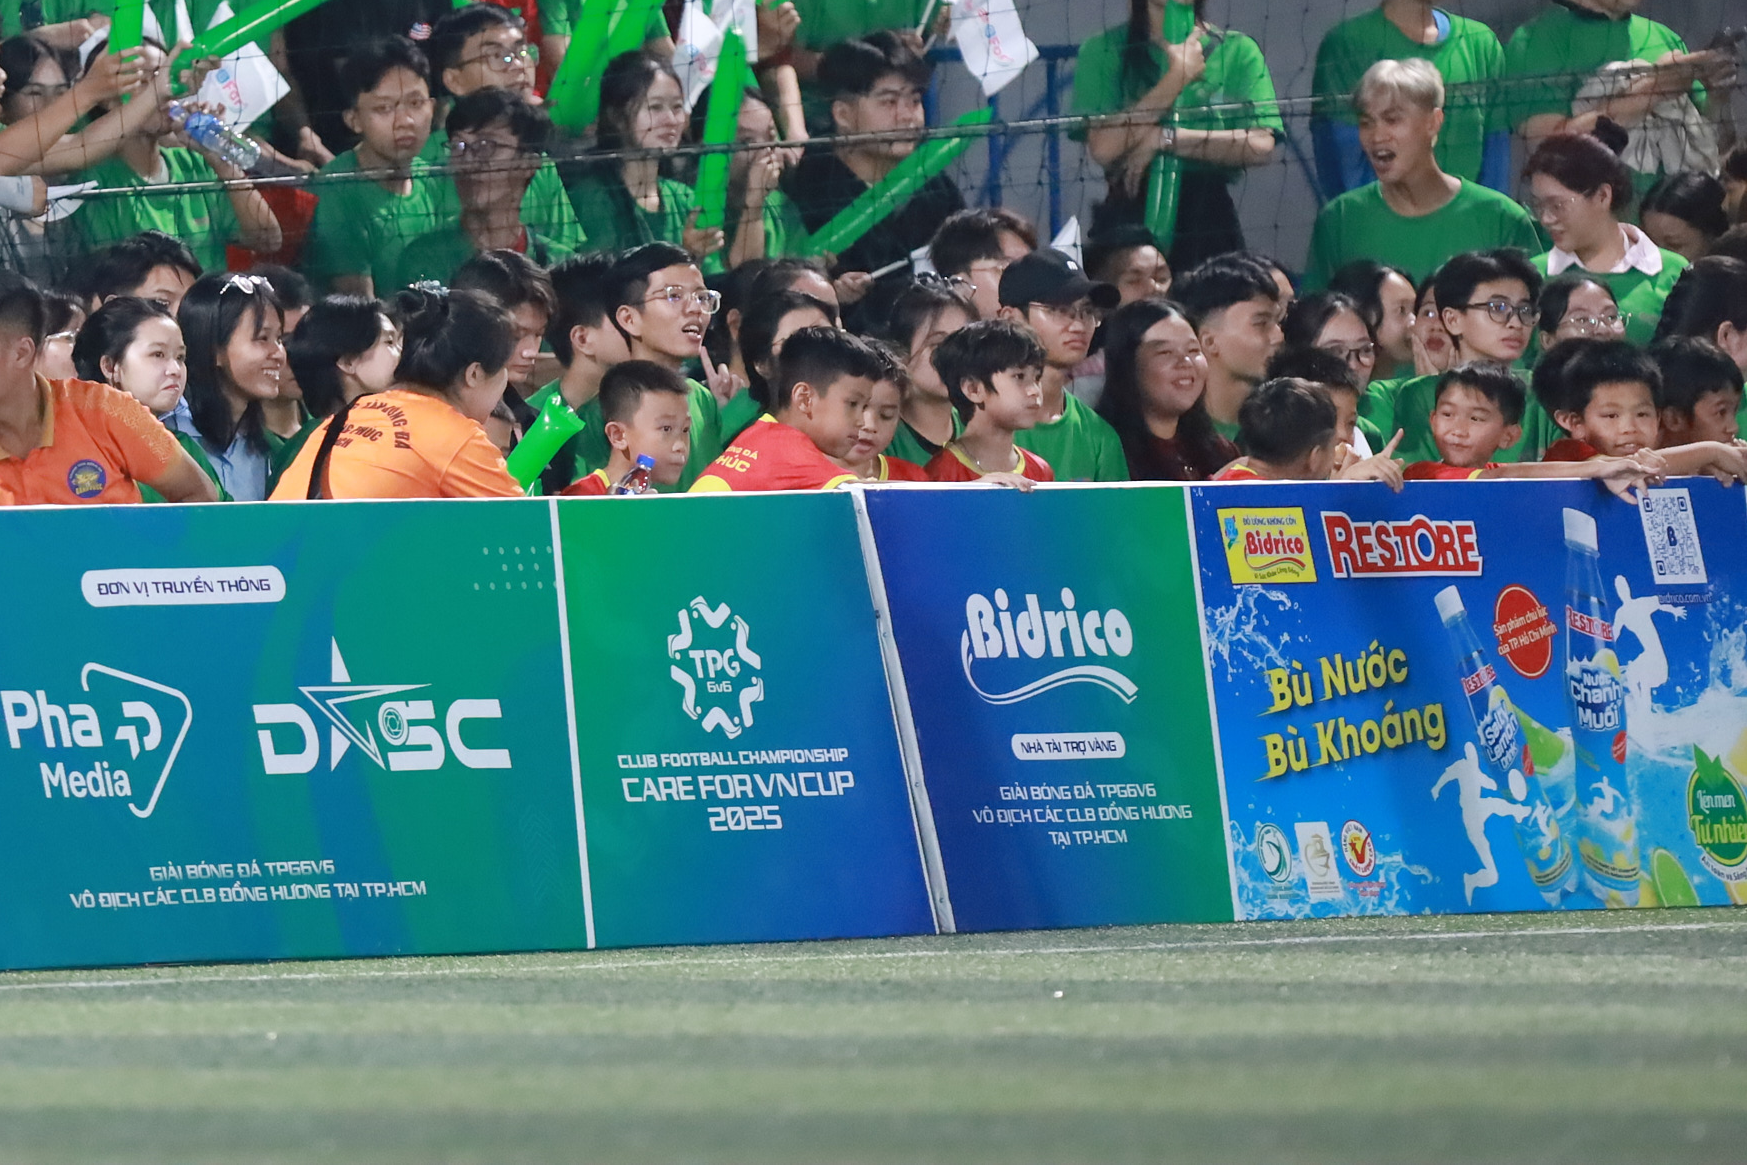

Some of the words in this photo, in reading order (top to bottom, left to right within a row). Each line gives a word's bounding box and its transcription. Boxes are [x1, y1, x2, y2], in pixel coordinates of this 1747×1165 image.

[715, 454, 751, 473] HÚC
[1245, 529, 1304, 555] Bidrico
[1321, 513, 1483, 576] RESTORE
[97, 580, 130, 596] ĐƠN
[133, 581, 150, 598] VỊ
[151, 575, 215, 594] TRUYỀN
[217, 576, 271, 592] THÔNG
[965, 587, 1133, 659] Bidrico
[688, 648, 741, 678] TPG
[1257, 659, 1314, 717] Bù
[1317, 639, 1409, 702] Nước
[1570, 680, 1621, 704] Chanh
[0, 689, 104, 749] Pha
[1021, 738, 1044, 754] NHÀ
[1045, 738, 1063, 754] TÀI
[1063, 740, 1087, 755] TRỢ
[1087, 737, 1117, 752] VÀNG
[1254, 724, 1310, 782] Bù
[1309, 699, 1447, 768] Khoáng
[617, 753, 658, 769] CLUB
[660, 751, 738, 767] FOOTBALL
[738, 748, 848, 765] CHAMPIONSHIP
[39, 761, 132, 798] Media
[621, 775, 696, 802] CARE
[999, 781, 1029, 801] GIẢI
[1030, 782, 1072, 801] BÓNG
[1073, 781, 1095, 799] ĐÁ
[1096, 783, 1157, 799] TPG6V6
[706, 805, 783, 832] 2025
[972, 805, 995, 824] VÔ
[996, 807, 1032, 827] ĐỊCH
[1033, 805, 1065, 823] CÁC
[1065, 807, 1096, 822] CLB
[1097, 801, 1140, 821] ĐỒNG
[1140, 804, 1193, 820] HƯƠNG
[1048, 830, 1071, 850] TẠI
[1071, 829, 1128, 846] TP.HCM
[1713, 814, 1747, 844] nhiê
[149, 861, 183, 882] GIẢI
[185, 860, 234, 879] BÓNG
[236, 859, 262, 877] ĐÁ
[264, 859, 335, 876] TPG6V6
[69, 889, 95, 909] VÔ
[98, 891, 141, 911] ĐỊCH
[143, 886, 179, 907] CÁC
[181, 887, 216, 903] CLB
[218, 880, 268, 902] ĐỒNG
[271, 883, 332, 901] HƯƠNG
[333, 882, 360, 902] TẠI
[361, 880, 427, 899] TP.HCM
